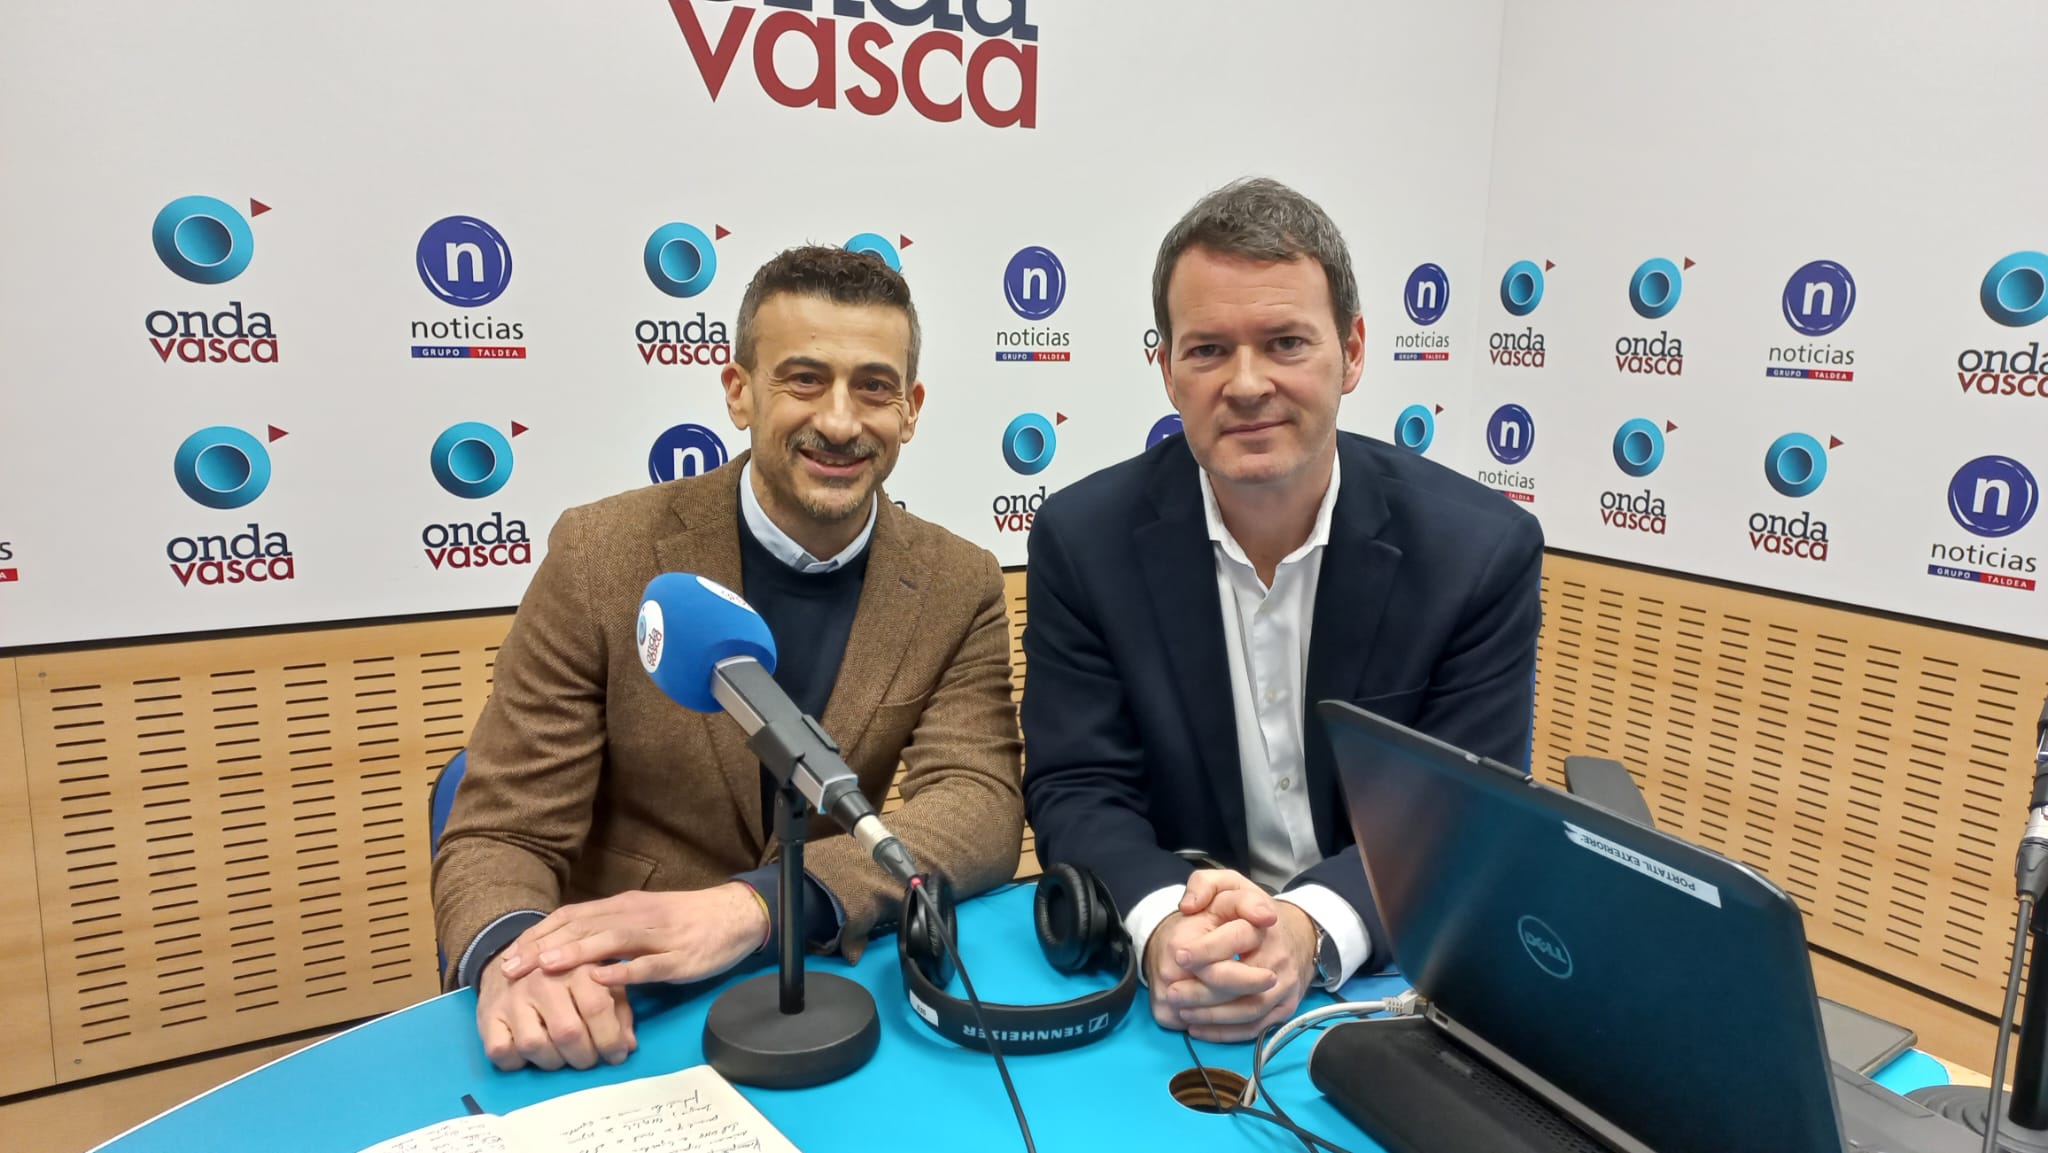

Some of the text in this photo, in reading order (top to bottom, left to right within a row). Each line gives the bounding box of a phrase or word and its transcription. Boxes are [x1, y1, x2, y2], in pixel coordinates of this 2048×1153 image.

[668, 0, 1038, 129] vasca
[445, 241, 485, 283] n
[1022, 266, 1048, 301] n
[1416, 280, 1437, 309] n
[1801, 280, 1835, 316] n
[145, 301, 277, 339] onda
[411, 315, 524, 341] noticias
[635, 311, 730, 345] onda
[149, 336, 279, 363] vasca
[996, 326, 1070, 347] noticias
[1395, 330, 1450, 348] noticias
[1489, 326, 1546, 351] onda
[1615, 330, 1684, 358] onda
[421, 348, 520, 358] GRUPO TALDEA
[638, 341, 731, 366] vasca
[1002, 353, 1028, 361] GRUPO
[1489, 349, 1545, 368] vasca
[1615, 355, 1683, 376] vasca
[1768, 343, 1855, 365] noticias
[1773, 369, 1847, 380] GRUPO TALDEA
[1498, 420, 1521, 450] n
[1477, 469, 1535, 490] noticias
[992, 485, 1046, 515] ond
[1600, 489, 1667, 517] onda
[1971, 477, 2011, 516] n
[422, 511, 530, 547] onda
[993, 513, 1033, 533] vas
[1600, 508, 1666, 535] vasca
[1748, 511, 1829, 543] onda
[166, 523, 293, 564] onda
[424, 541, 532, 570] vasca
[1749, 531, 1828, 562] vasca
[170, 555, 295, 588] vasca
[1931, 543, 2037, 573] noticias
[1936, 567, 2027, 588] GRUPO TALDEA
[1580, 834, 1697, 892] PORTATIL EXTERIORE
[1524, 930, 1568, 965] DELL
[962, 1024, 1084, 1041] SENNHEISER
